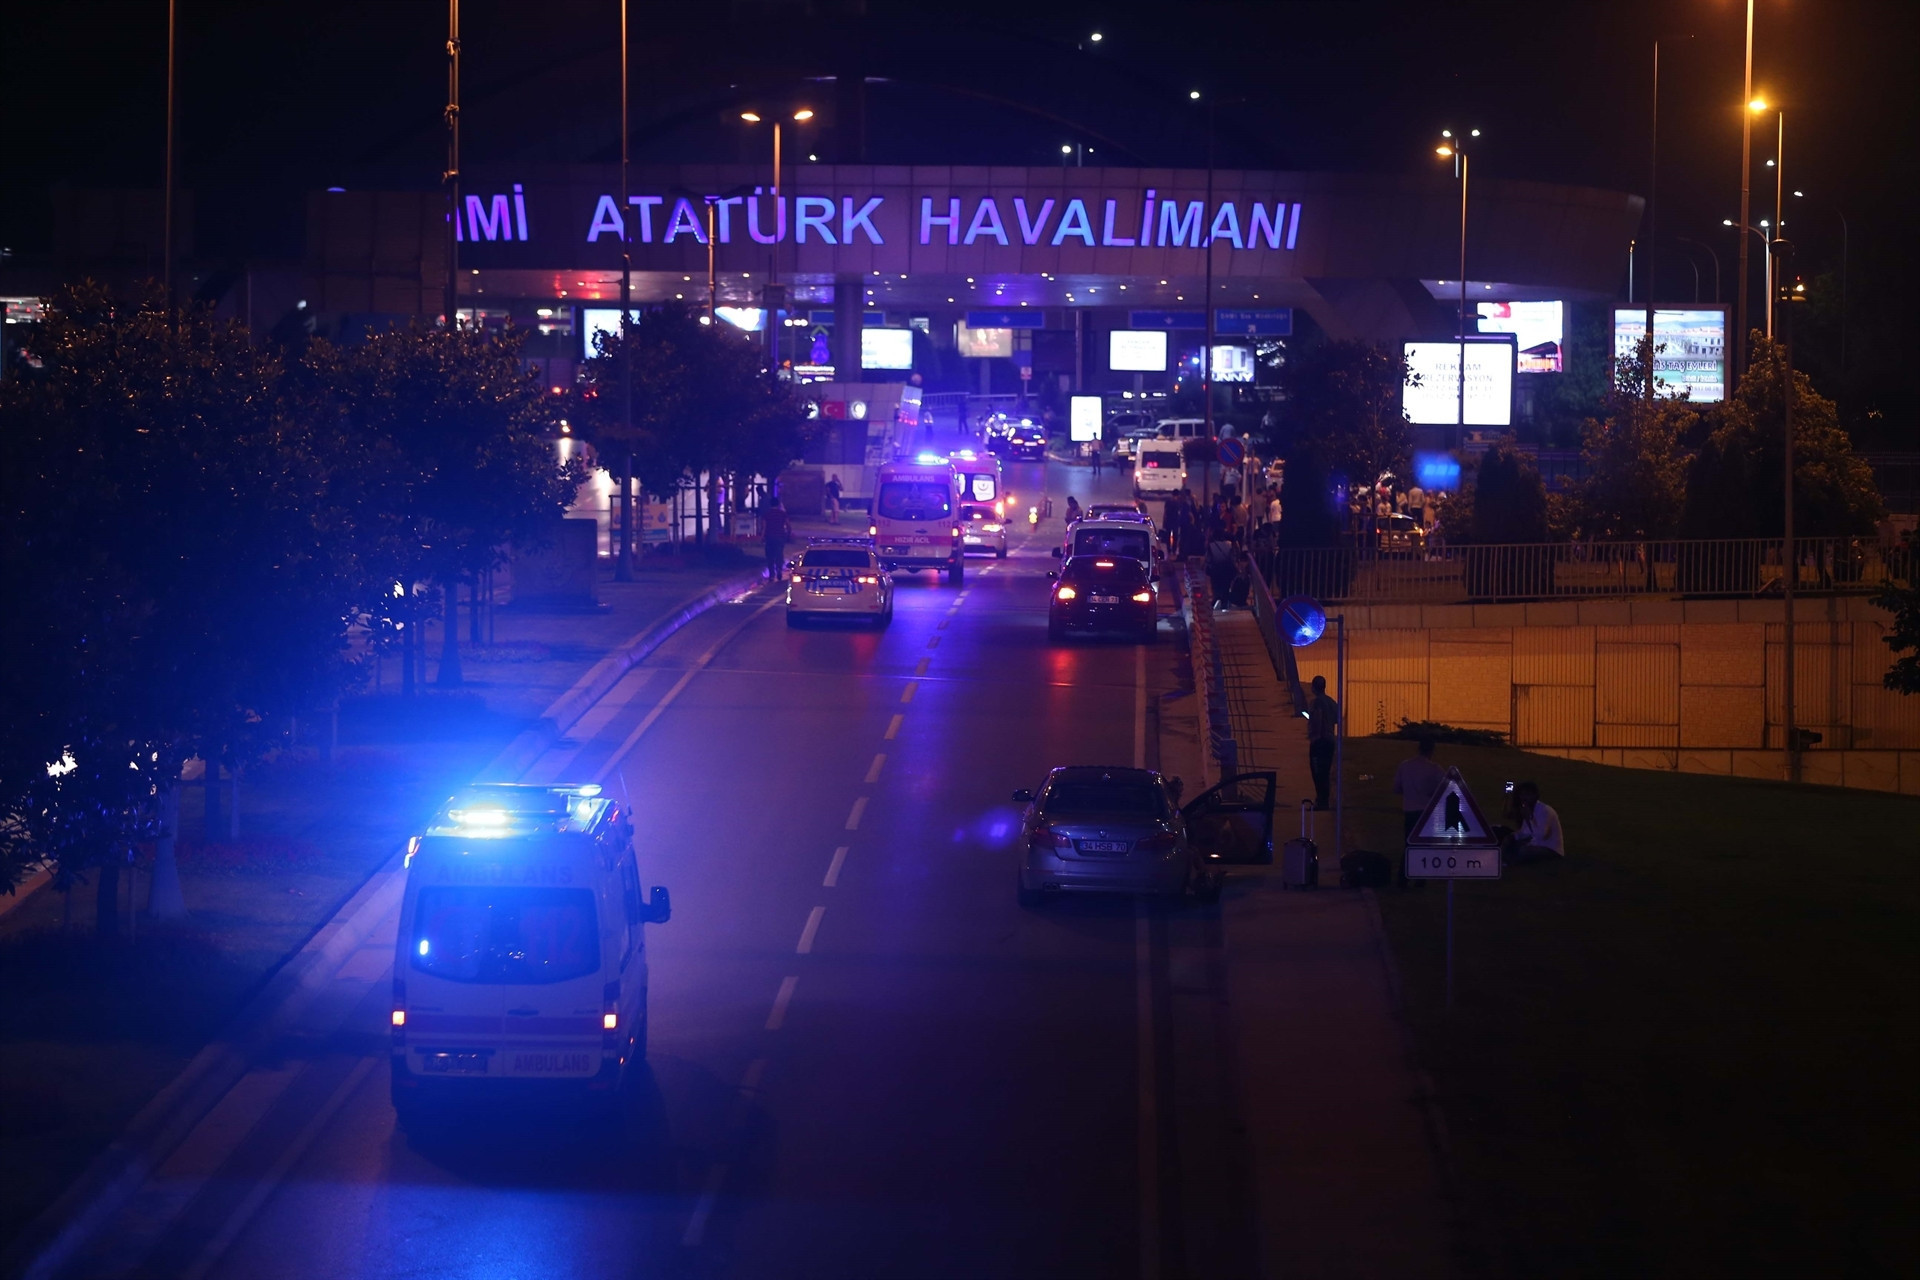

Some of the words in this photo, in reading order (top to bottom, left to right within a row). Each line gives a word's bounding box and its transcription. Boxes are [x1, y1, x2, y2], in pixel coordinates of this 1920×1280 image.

[587, 187, 885, 244] ATATÜRK
[919, 189, 1302, 250] HAVALİMANI
[1435, 362, 1482, 371] REKAM
[1421, 856, 1457, 869] 100
[1466, 860, 1481, 869] m
[513, 1054, 590, 1072] AMBULANS
